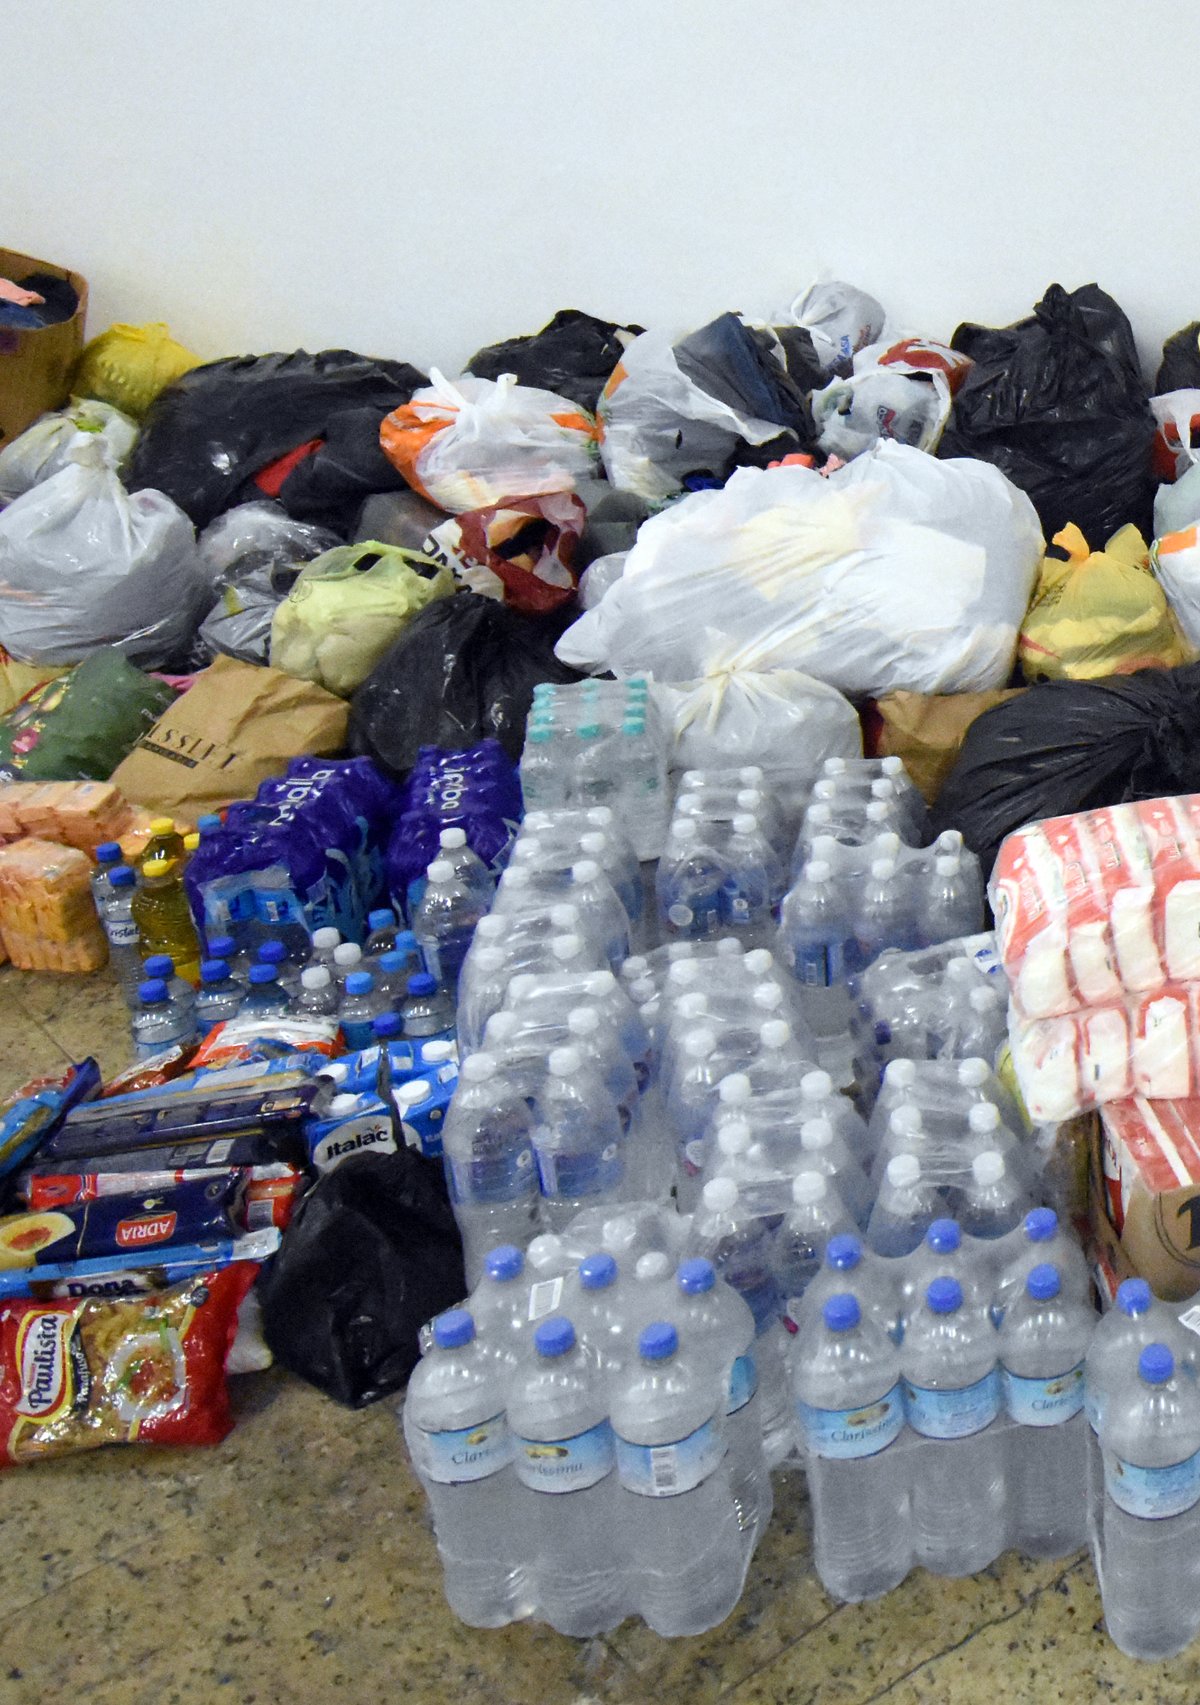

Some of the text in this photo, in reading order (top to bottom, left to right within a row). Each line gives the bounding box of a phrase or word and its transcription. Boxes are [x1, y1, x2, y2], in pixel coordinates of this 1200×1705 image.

[326, 1130, 389, 1160] Italac
[121, 1220, 171, 1241] ADRIA
[29, 1315, 58, 1409] Paulista
